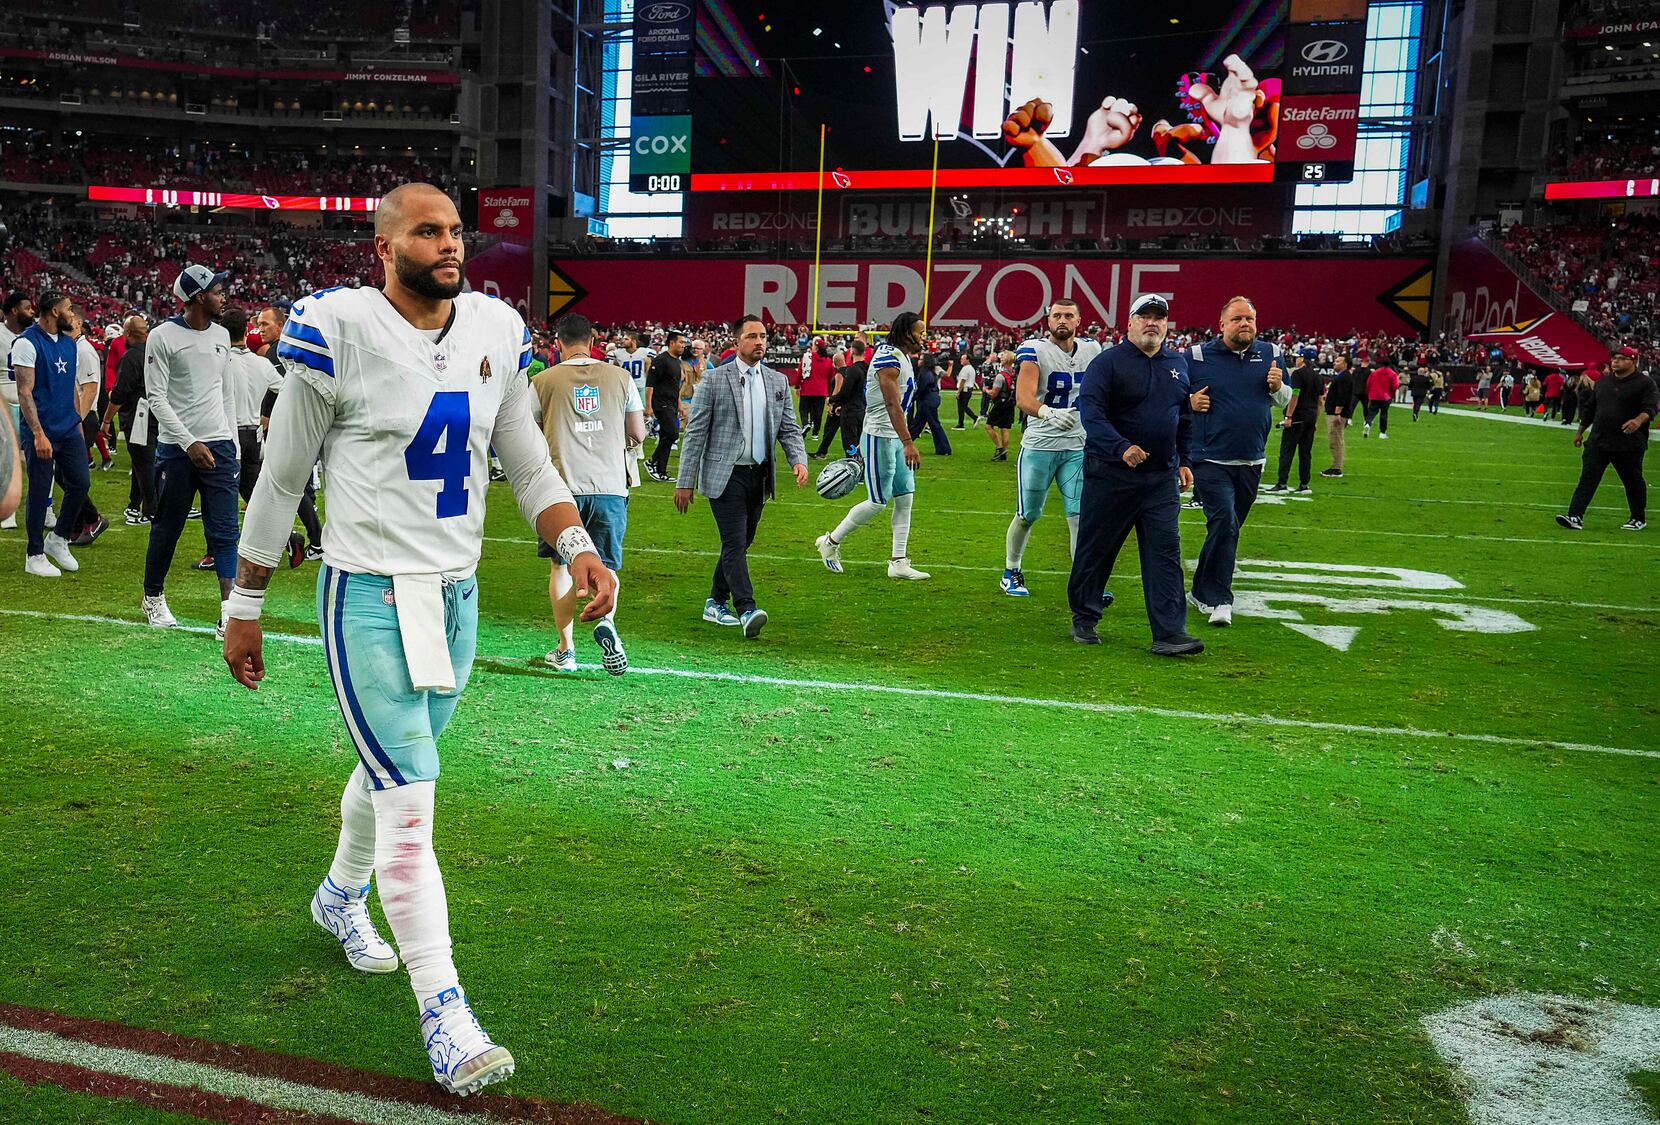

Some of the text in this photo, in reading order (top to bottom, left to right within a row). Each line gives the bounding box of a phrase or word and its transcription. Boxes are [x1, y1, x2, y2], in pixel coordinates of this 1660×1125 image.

[648, 5, 680, 20] Ford
[648, 28, 680, 36] ARIZONA
[1598, 21, 1660, 35] JOHN (PA
[658, 34, 690, 42] DEALERS
[49, 52, 82, 62] ADRIAN
[83, 55, 117, 65] WILSON
[344, 73, 427, 82] JIMMY CONZELMAN
[635, 72, 689, 82] GILA RIVER
[890, 0, 1080, 141] WIN
[1292, 64, 1353, 77] HYUNDAI
[635, 135, 688, 155] COX
[1304, 165, 1323, 179] 25
[648, 175, 680, 191] 0:00
[712, 211, 818, 231] REDZONE
[848, 200, 1096, 236] BUD IGHT
[1127, 207, 1253, 228] REDZONE
[743, 262, 1180, 328] REDZONE
[621, 360, 643, 379] 40
[577, 396, 597, 411] NFL
[574, 419, 604, 433] MEDIA
[587, 435, 593, 448] 1
[404, 391, 472, 519] 4
